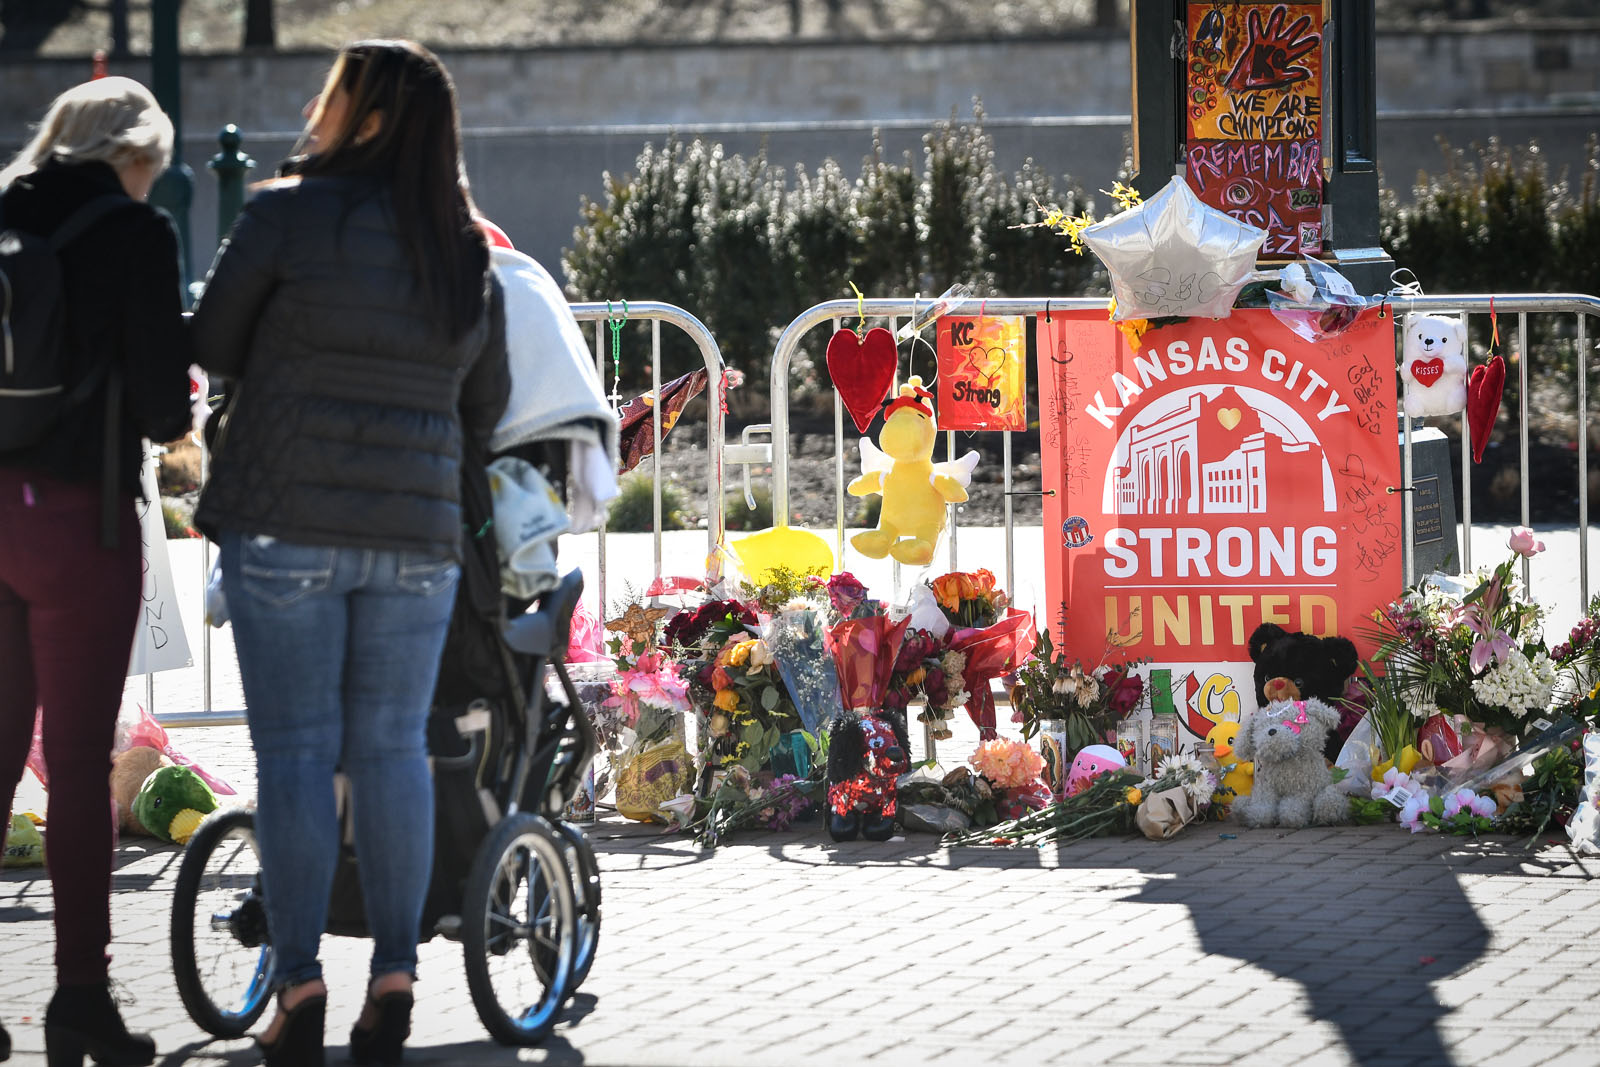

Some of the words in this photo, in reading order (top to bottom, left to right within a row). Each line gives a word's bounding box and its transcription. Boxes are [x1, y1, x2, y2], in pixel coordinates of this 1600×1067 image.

[1230, 94, 1267, 114] WE
[1272, 94, 1320, 117] ARE
[951, 322, 974, 346] KC
[1085, 337, 1250, 429] KANSAS
[1261, 349, 1351, 422] CITY
[1347, 354, 1374, 385] God
[952, 381, 1001, 408] Strong
[1353, 370, 1383, 404] Bless
[1103, 526, 1337, 578] STRONG
